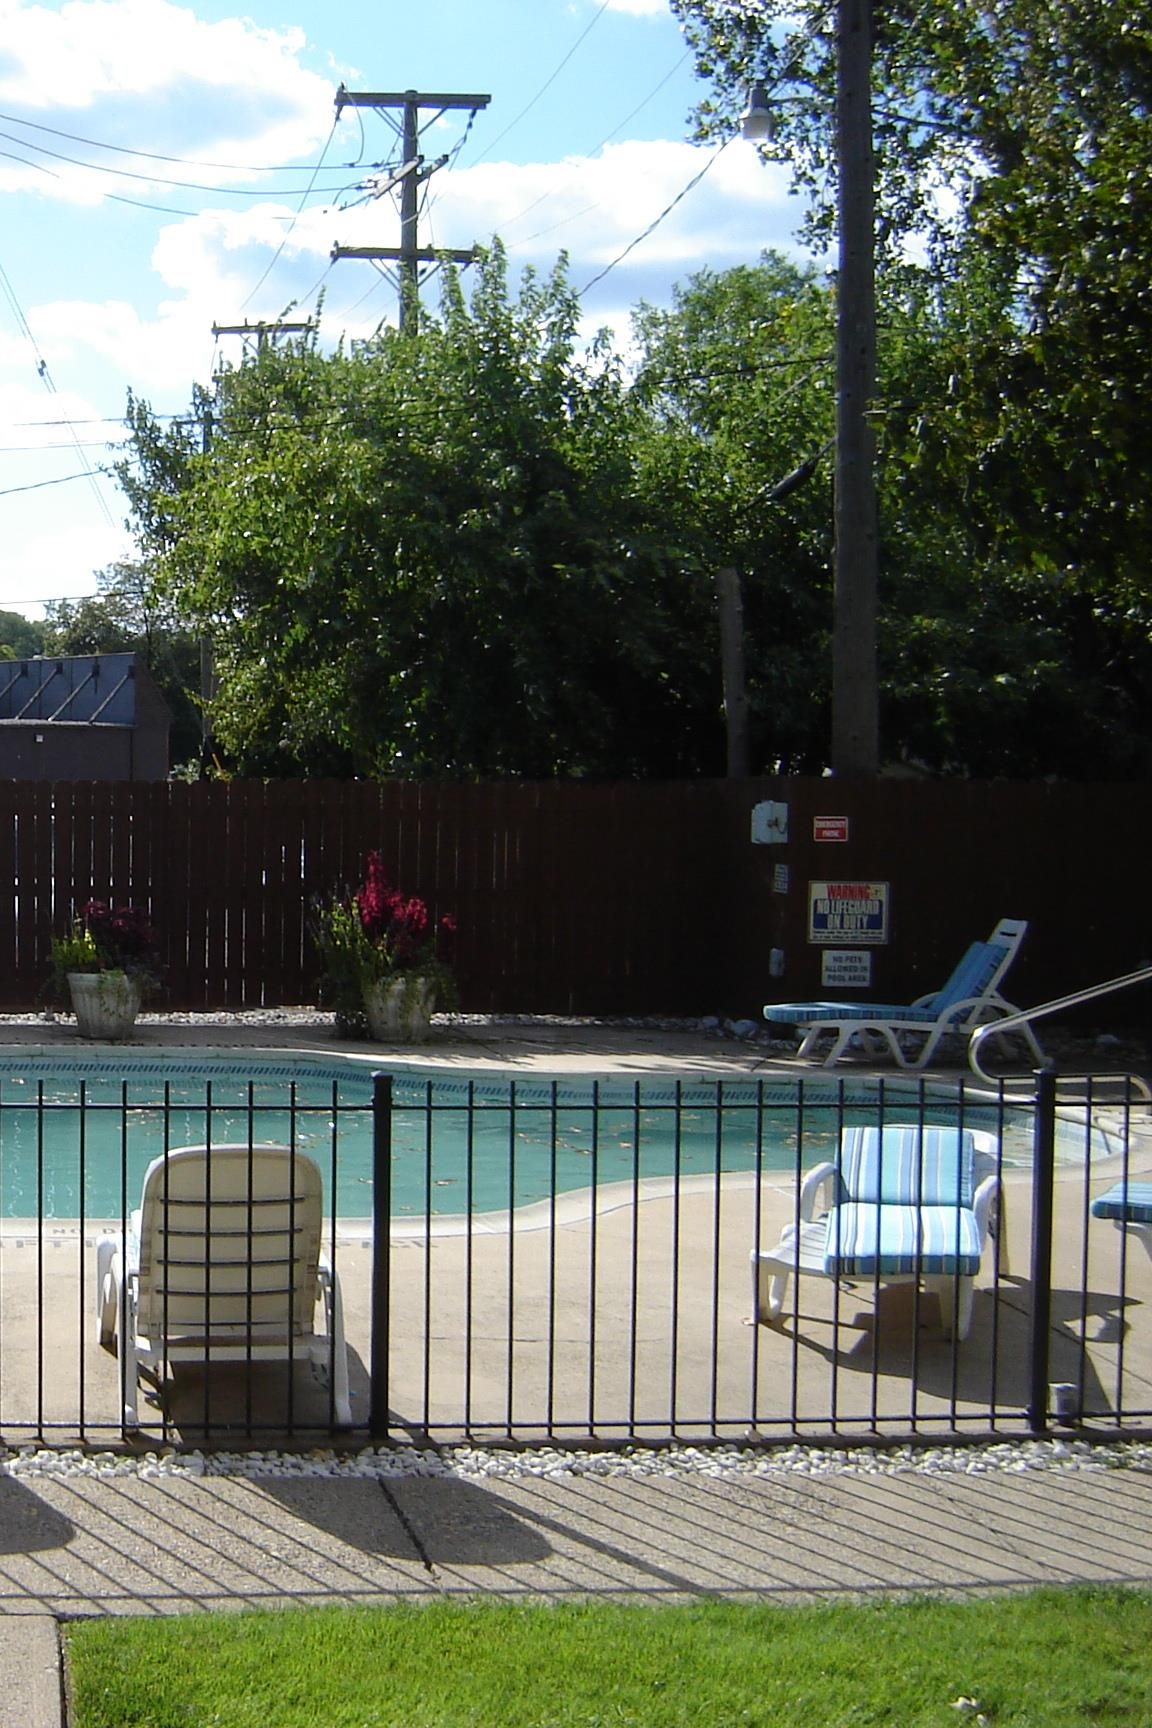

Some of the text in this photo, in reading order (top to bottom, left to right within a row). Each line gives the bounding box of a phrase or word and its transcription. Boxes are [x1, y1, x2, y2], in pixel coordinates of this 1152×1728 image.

[827, 884, 870, 899] WARNING
[816, 900, 880, 914] NO LIFEGUARD
[827, 914, 868, 928] ON DUTY
[832, 955, 862, 963] NO PETS
[825, 965, 858, 973] ALLOWED
[827, 974, 866, 982] POOL AREA
